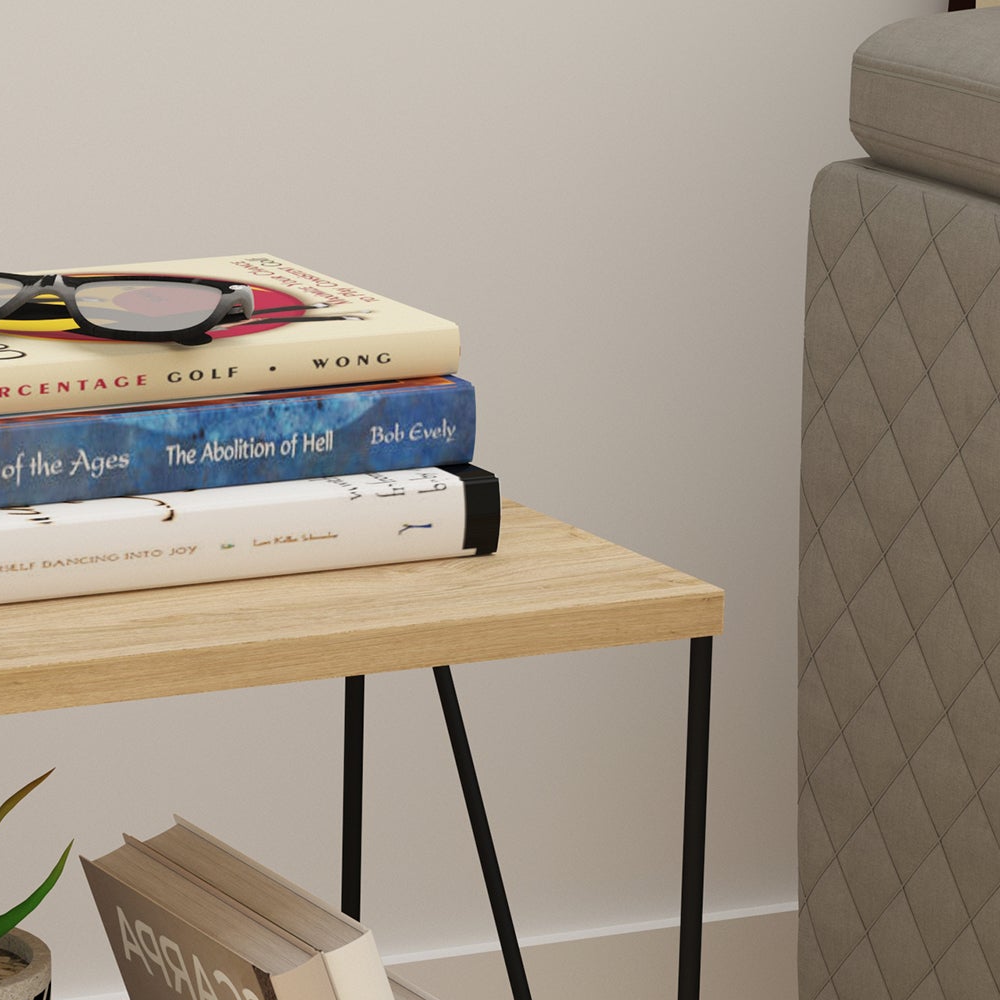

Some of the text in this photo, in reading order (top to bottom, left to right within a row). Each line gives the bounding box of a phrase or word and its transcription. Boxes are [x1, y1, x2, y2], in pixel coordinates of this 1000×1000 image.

[166, 365, 240, 384] GOLF
[312, 351, 393, 370] WONG
[165, 430, 334, 467] The Abolition of Hell
[369, 418, 458, 446] Bob Evely
[1, 450, 26, 487] of
[29, 450, 63, 477] the
[69, 448, 131, 479] Ages
[42, 551, 121, 569] DANCING
[123, 548, 164, 560] INTO
[168, 545, 198, 557] JOY
